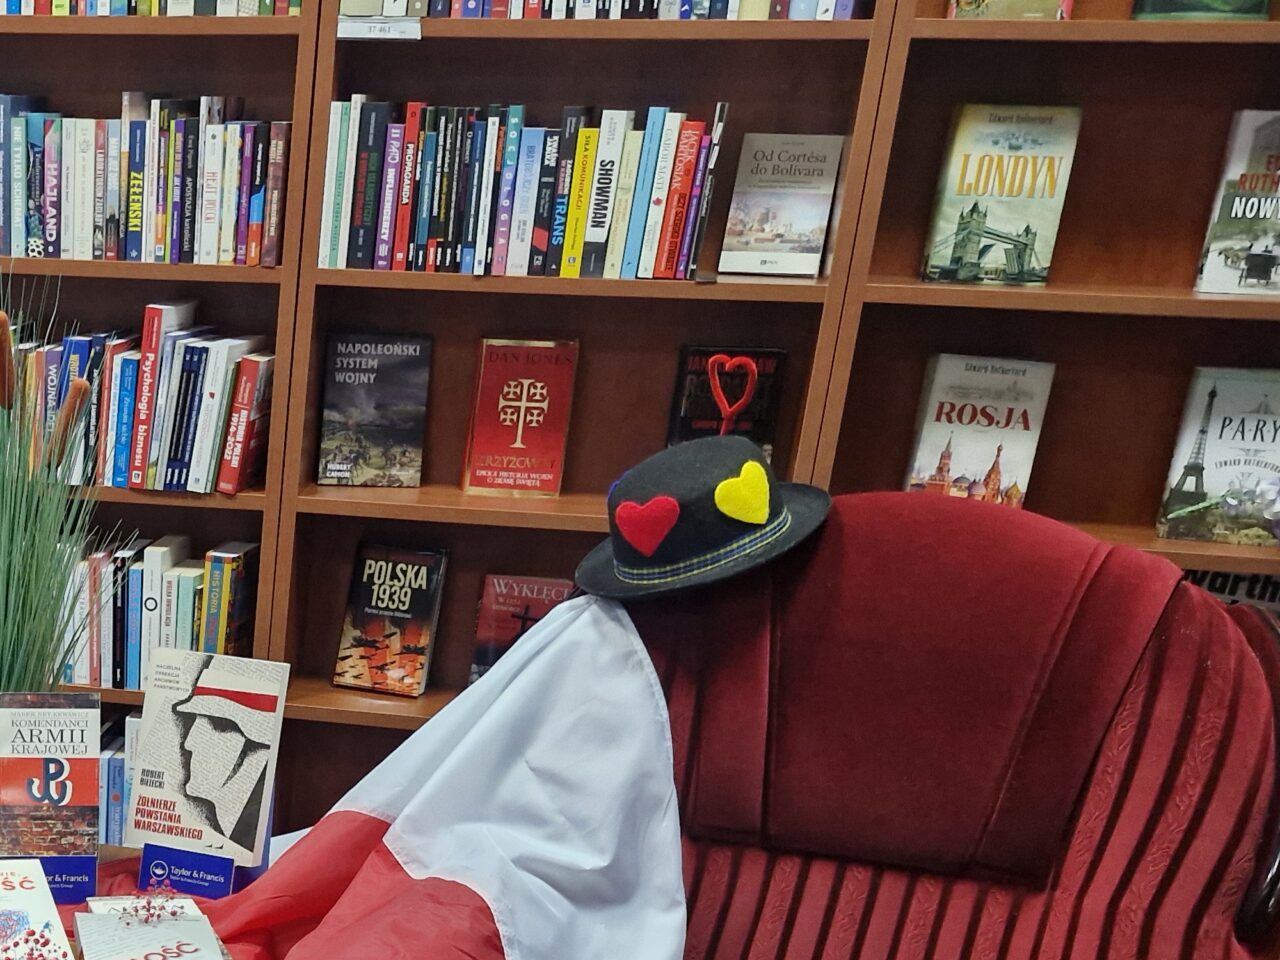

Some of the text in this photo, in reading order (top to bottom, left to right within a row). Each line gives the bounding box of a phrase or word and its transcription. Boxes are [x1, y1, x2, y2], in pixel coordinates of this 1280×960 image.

[671, 129, 689, 190] BARTOSIAK
[753, 150, 827, 164] Od Cortésa
[13, 127, 23, 229] NIE TYLKO SCHEMAT
[401, 143, 414, 204] PROPAGANDA
[497, 117, 519, 245] SOCJOLOGIA
[575, 135, 591, 211] SIŁA KOMUNIKACJI
[750, 163, 825, 178] do Bolívara
[955, 152, 1064, 199] LONDYN
[1238, 172, 1280, 193] RUTH
[45, 162, 59, 242] HAJLAND
[590, 159, 615, 229] SHOWMAN
[183, 177, 193, 251] APOSTAZJA katoliczki
[551, 196, 568, 246] TRANS
[337, 342, 420, 356] NAPOLEOŃSKI
[335, 357, 378, 369] SYSTEM
[46, 364, 58, 406] WOJNA
[335, 371, 377, 384] WOJNY
[134, 352, 155, 466] Psychologia biznesu
[933, 400, 1031, 432] ROSJA
[230, 409, 248, 467] HISTORIA POLSKI
[362, 559, 427, 589] POLSKA
[209, 570, 220, 614] HISTORIA
[370, 584, 411, 610] 1939
[11, 719, 88, 728] KOMENDANCI
[11, 728, 86, 744] ARMII
[11, 743, 88, 755] KRAJOWEJ
[139, 777, 165, 789] BIELECKI
[141, 768, 165, 780] ROBERT
[136, 793, 177, 812] ŻOŁNIERZE
[135, 808, 182, 825] POWSTANIA
[133, 819, 203, 841] WARSZAWSKIEGO
[54, 874, 89, 882] & Francis
[170, 865, 225, 883] Taylor & Francis
